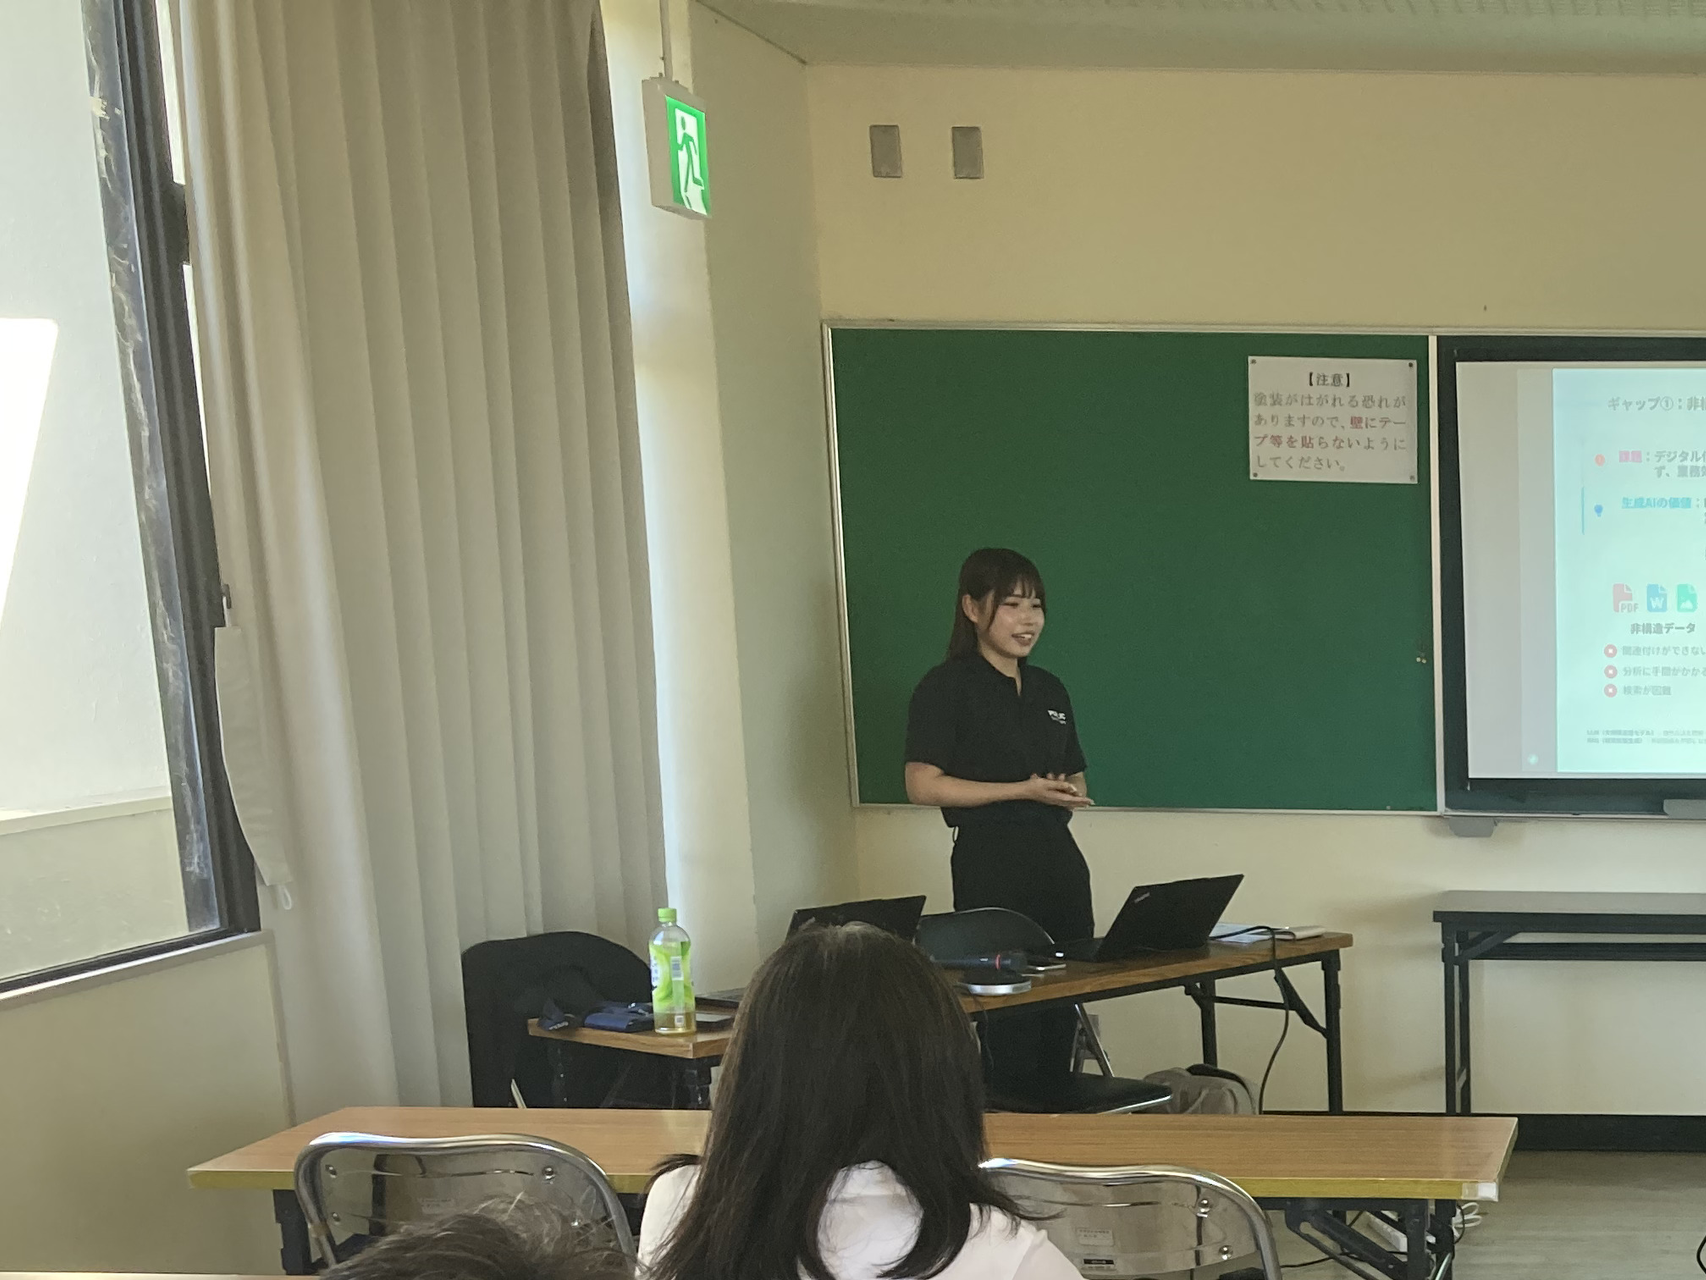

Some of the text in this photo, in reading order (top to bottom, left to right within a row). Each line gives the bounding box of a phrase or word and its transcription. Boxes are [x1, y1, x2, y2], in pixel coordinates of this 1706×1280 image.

[1309, 372, 1350, 388] 【注意】
[1254, 391, 1407, 409] 塗装がはがれる恐れが
[1253, 413, 1407, 430] ありますので、壁にテー
[1254, 434, 1407, 451] プ等を貼らないように
[1256, 454, 1346, 472] してください。
[1630, 622, 1696, 635] 非構造データ
